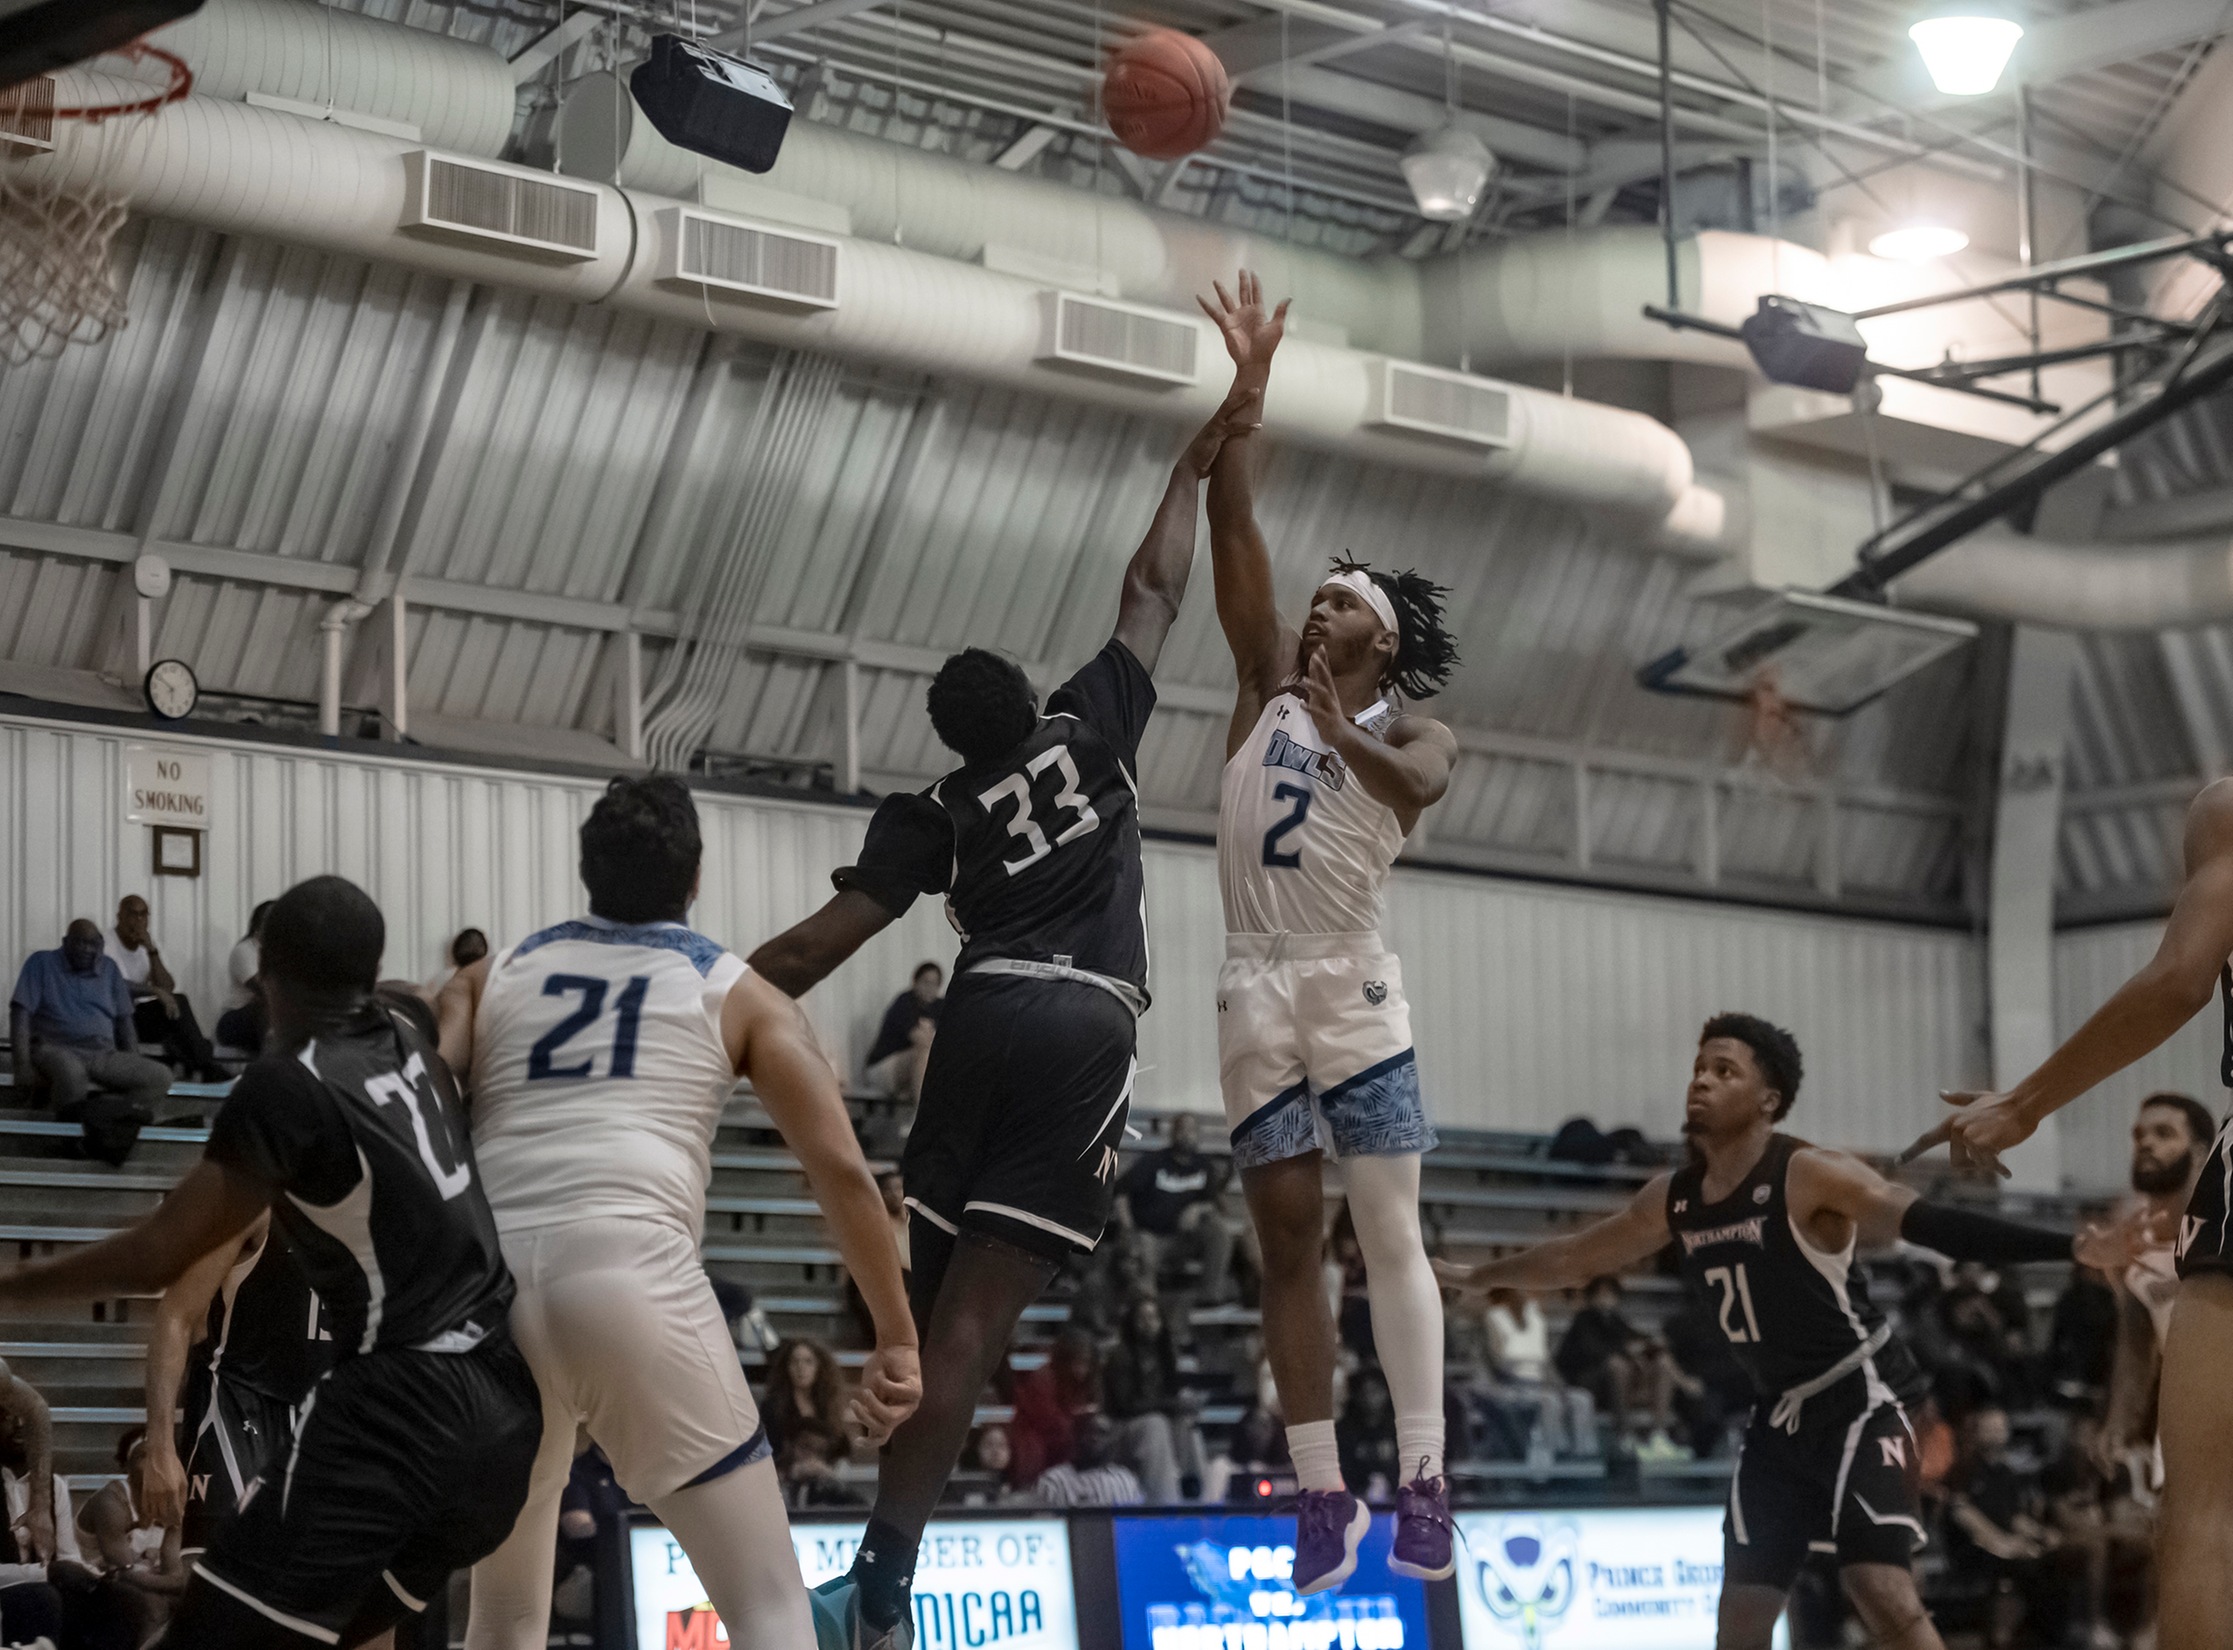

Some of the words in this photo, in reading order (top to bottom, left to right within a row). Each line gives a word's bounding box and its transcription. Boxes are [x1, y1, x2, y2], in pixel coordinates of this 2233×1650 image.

[157, 759, 182, 781] NO
[1262, 728, 1347, 792] OWLS
[135, 789, 204, 815] SMOKING
[977, 744, 1100, 877] 33
[1262, 781, 1311, 868] 2
[527, 973, 651, 1080] 21
[1704, 1262, 1762, 1343] 21
[1877, 1435, 1907, 1470] N
[189, 1473, 213, 1502] N
